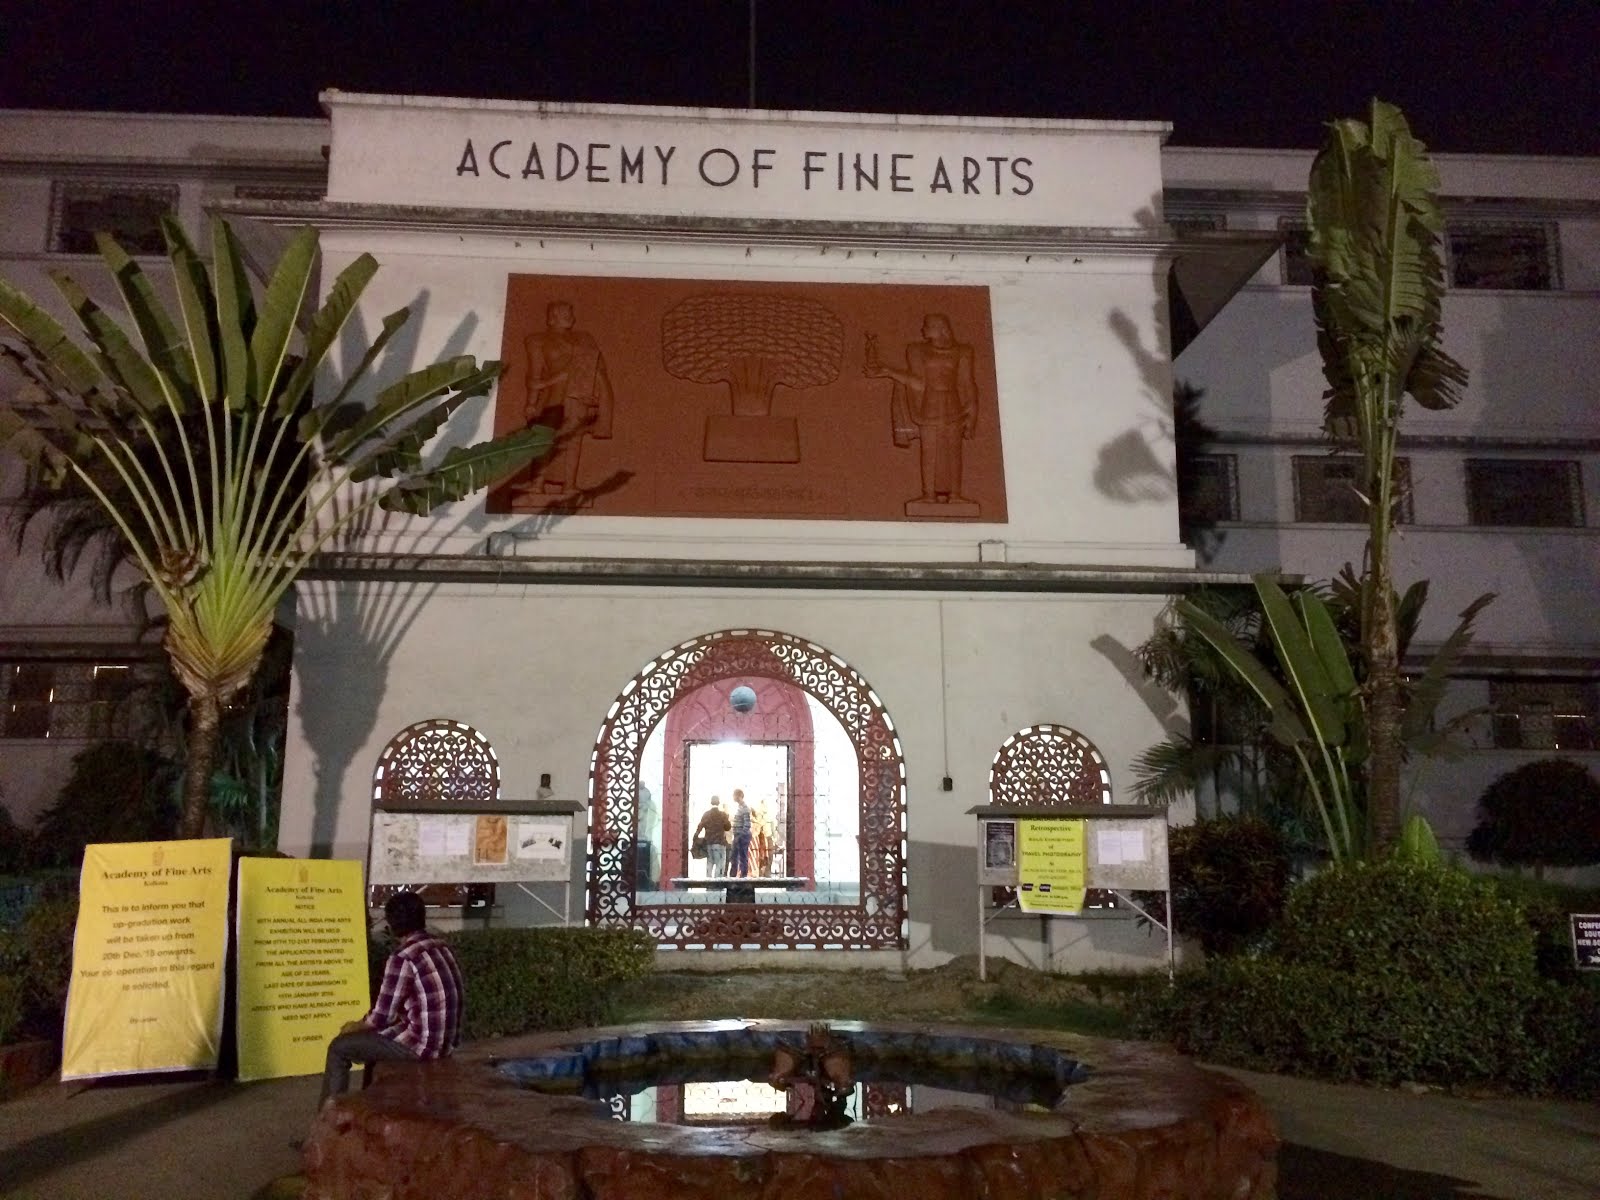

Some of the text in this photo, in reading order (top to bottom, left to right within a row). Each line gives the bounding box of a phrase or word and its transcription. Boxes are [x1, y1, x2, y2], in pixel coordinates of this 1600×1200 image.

[457, 139, 1034, 196] ACADEMY OF FINE ARTS
[1030, 825, 1072, 833] Retrospective
[103, 869, 147, 879] Academy
[152, 869, 161, 877] of
[191, 867, 212, 875] Arts
[102, 905, 119, 913] This
[142, 903, 168, 911] inform
[80, 969, 100, 978] Your
